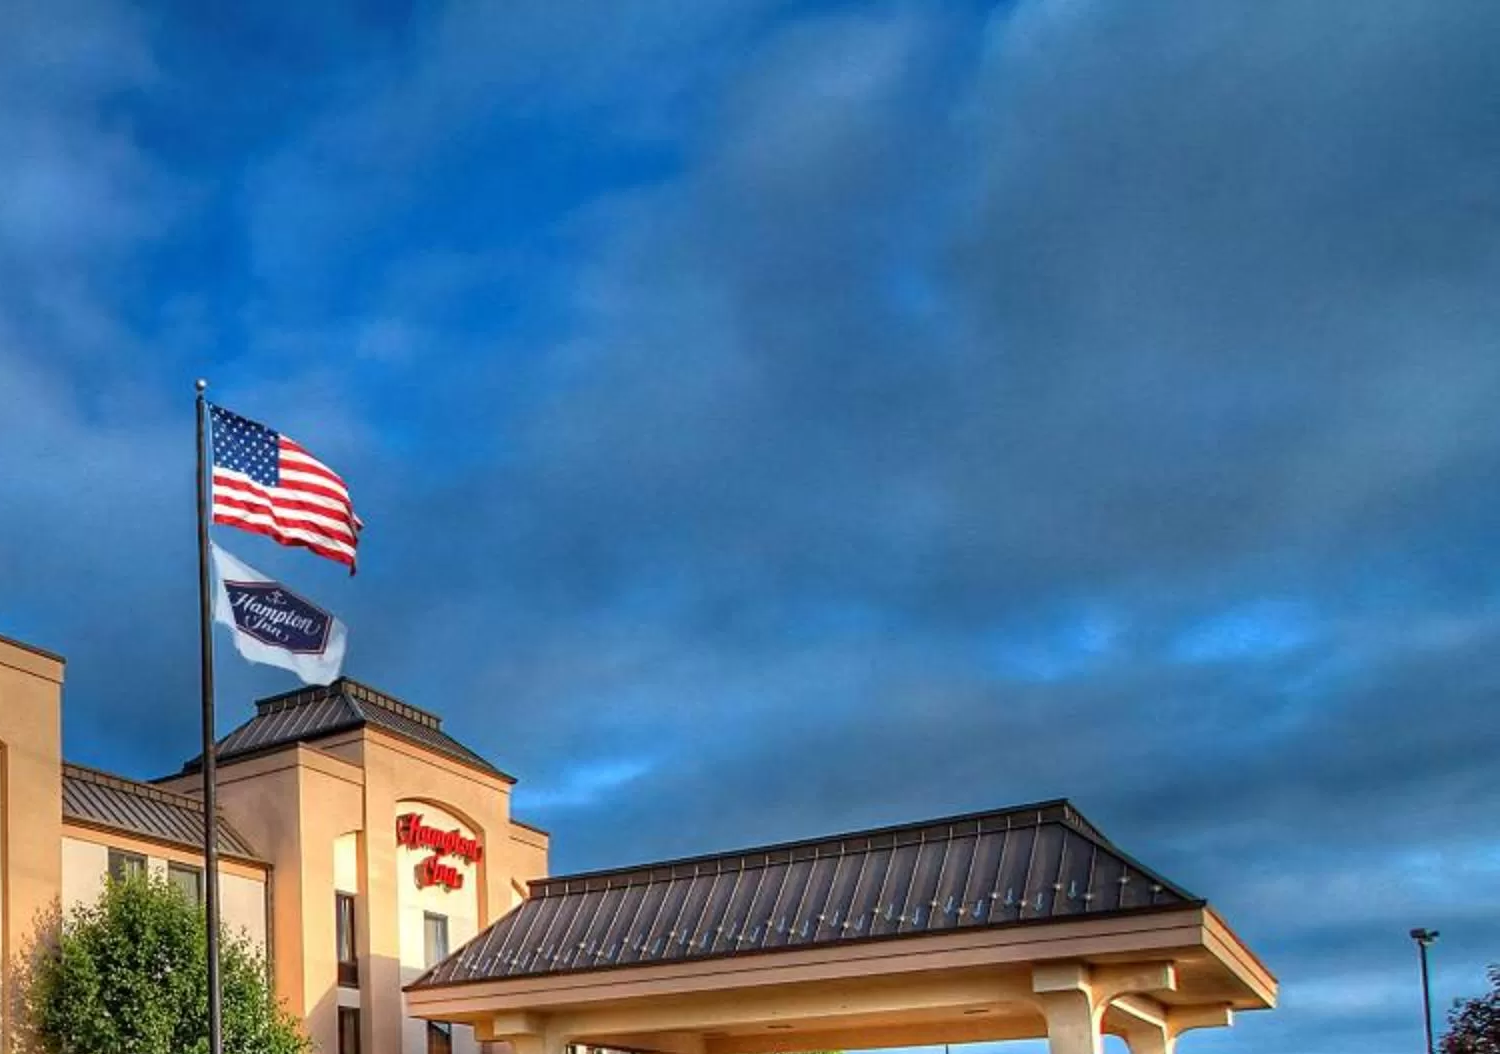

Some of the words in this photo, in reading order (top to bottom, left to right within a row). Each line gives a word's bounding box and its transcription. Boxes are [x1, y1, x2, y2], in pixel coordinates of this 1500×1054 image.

[231, 591, 320, 636] Hampton
[245, 615, 289, 642] Inn
[396, 812, 482, 865] Hampton
